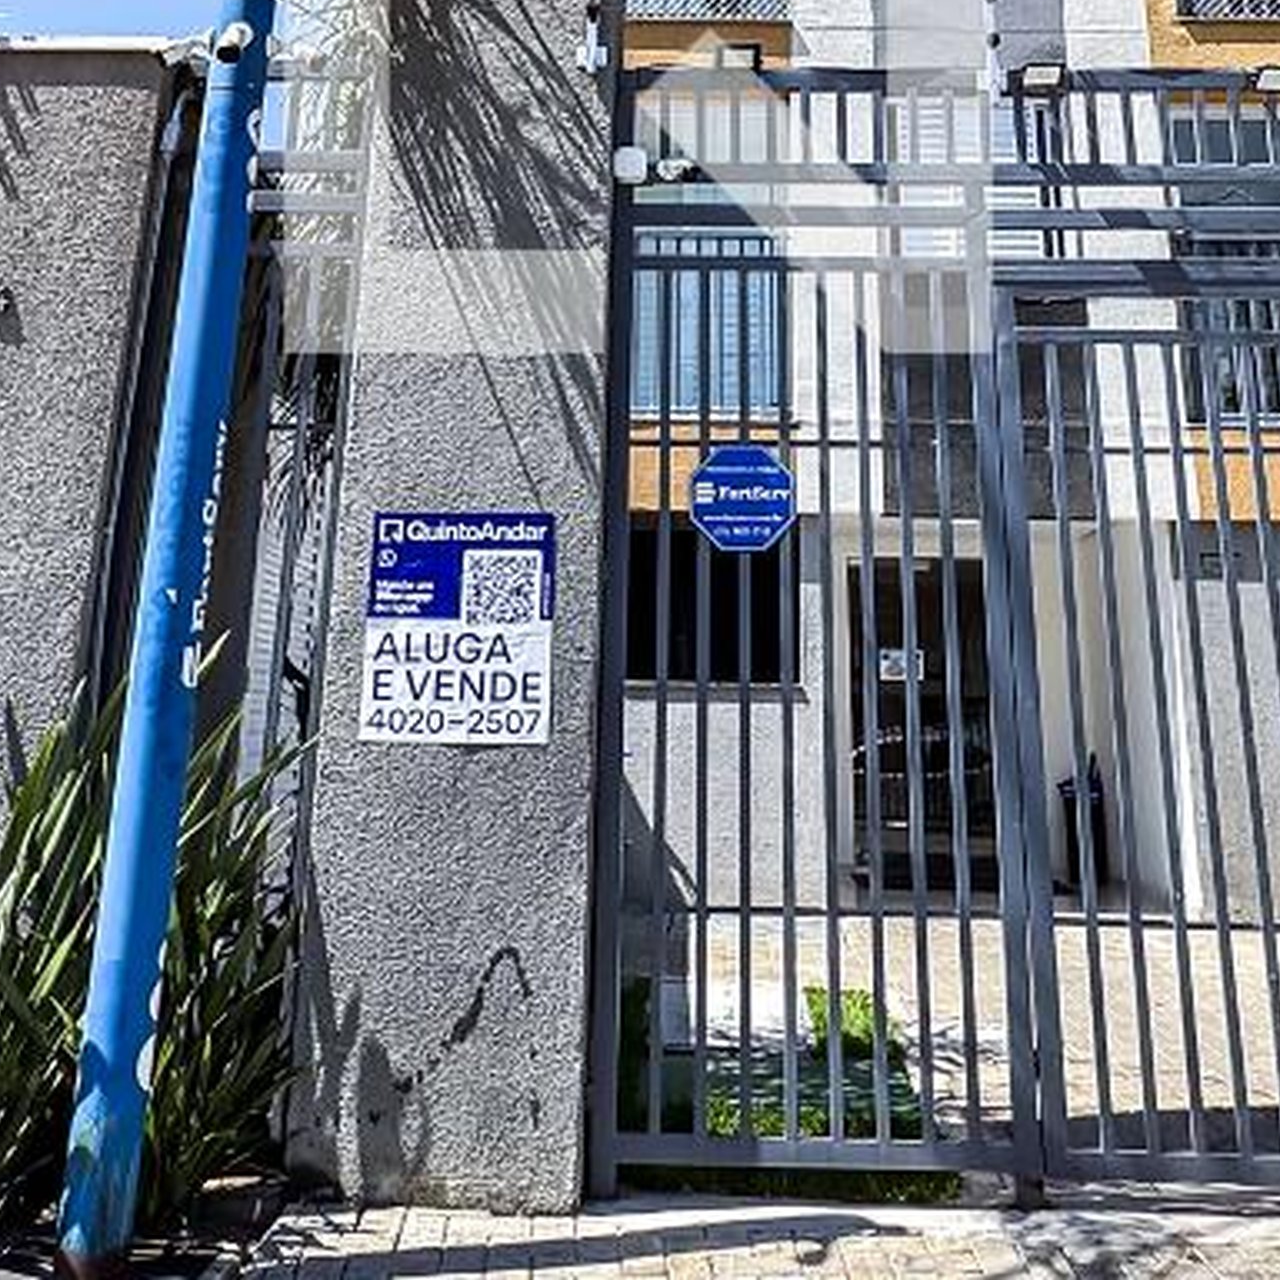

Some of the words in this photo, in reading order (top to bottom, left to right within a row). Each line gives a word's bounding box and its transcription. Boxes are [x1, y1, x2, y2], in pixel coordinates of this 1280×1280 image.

[406, 519, 548, 542] QuintoAndar
[372, 632, 512, 664] ALUGA
[372, 669, 394, 701] E
[405, 670, 541, 704] VENDE
[366, 708, 541, 735] 4020-2507
